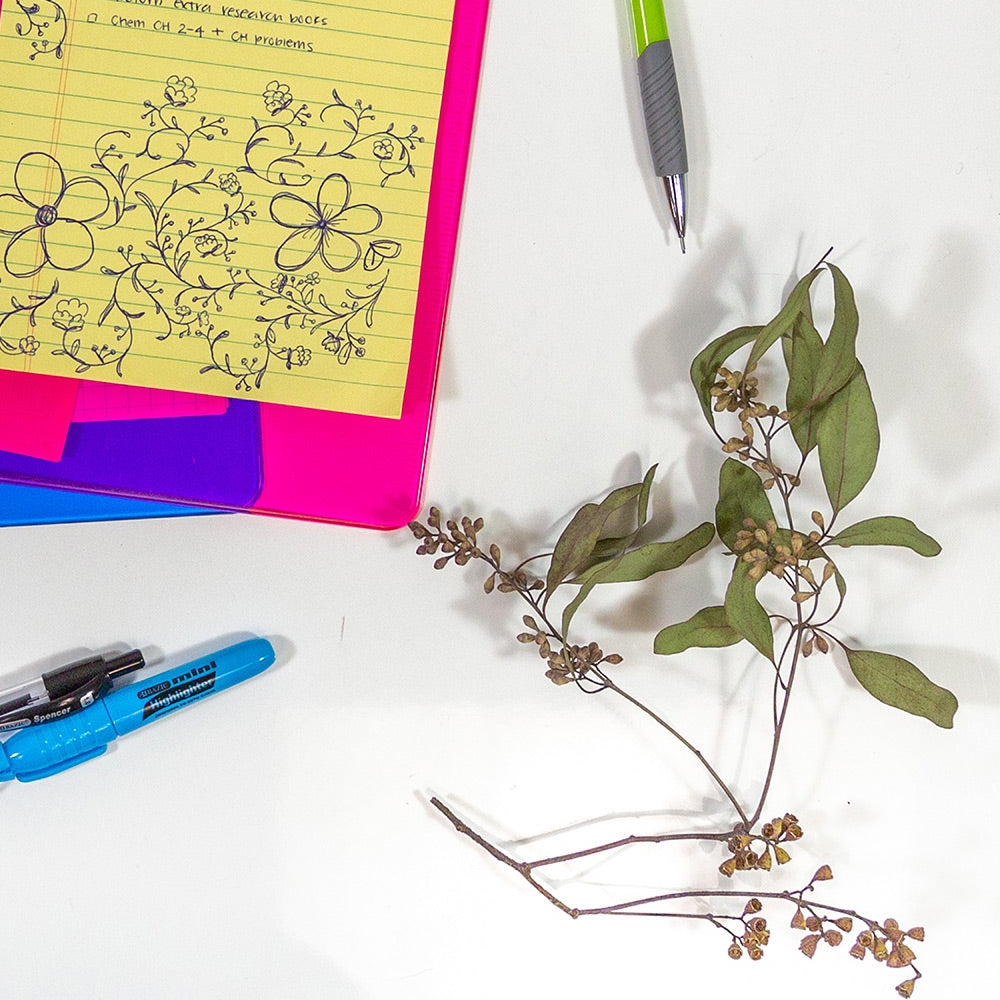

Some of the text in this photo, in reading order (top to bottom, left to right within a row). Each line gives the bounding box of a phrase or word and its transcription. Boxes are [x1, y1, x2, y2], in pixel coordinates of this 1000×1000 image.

[221, 5, 284, 22] research
[289, 13, 329, 26] books
[110, 14, 145, 29] Chem
[153, 20, 171, 32] CH
[230, 31, 249, 43] CH
[254, 34, 314, 53] problems
[171, 660, 217, 685] mini
[149, 678, 213, 710] Highlighter
[34, 705, 71, 723] Spencer
